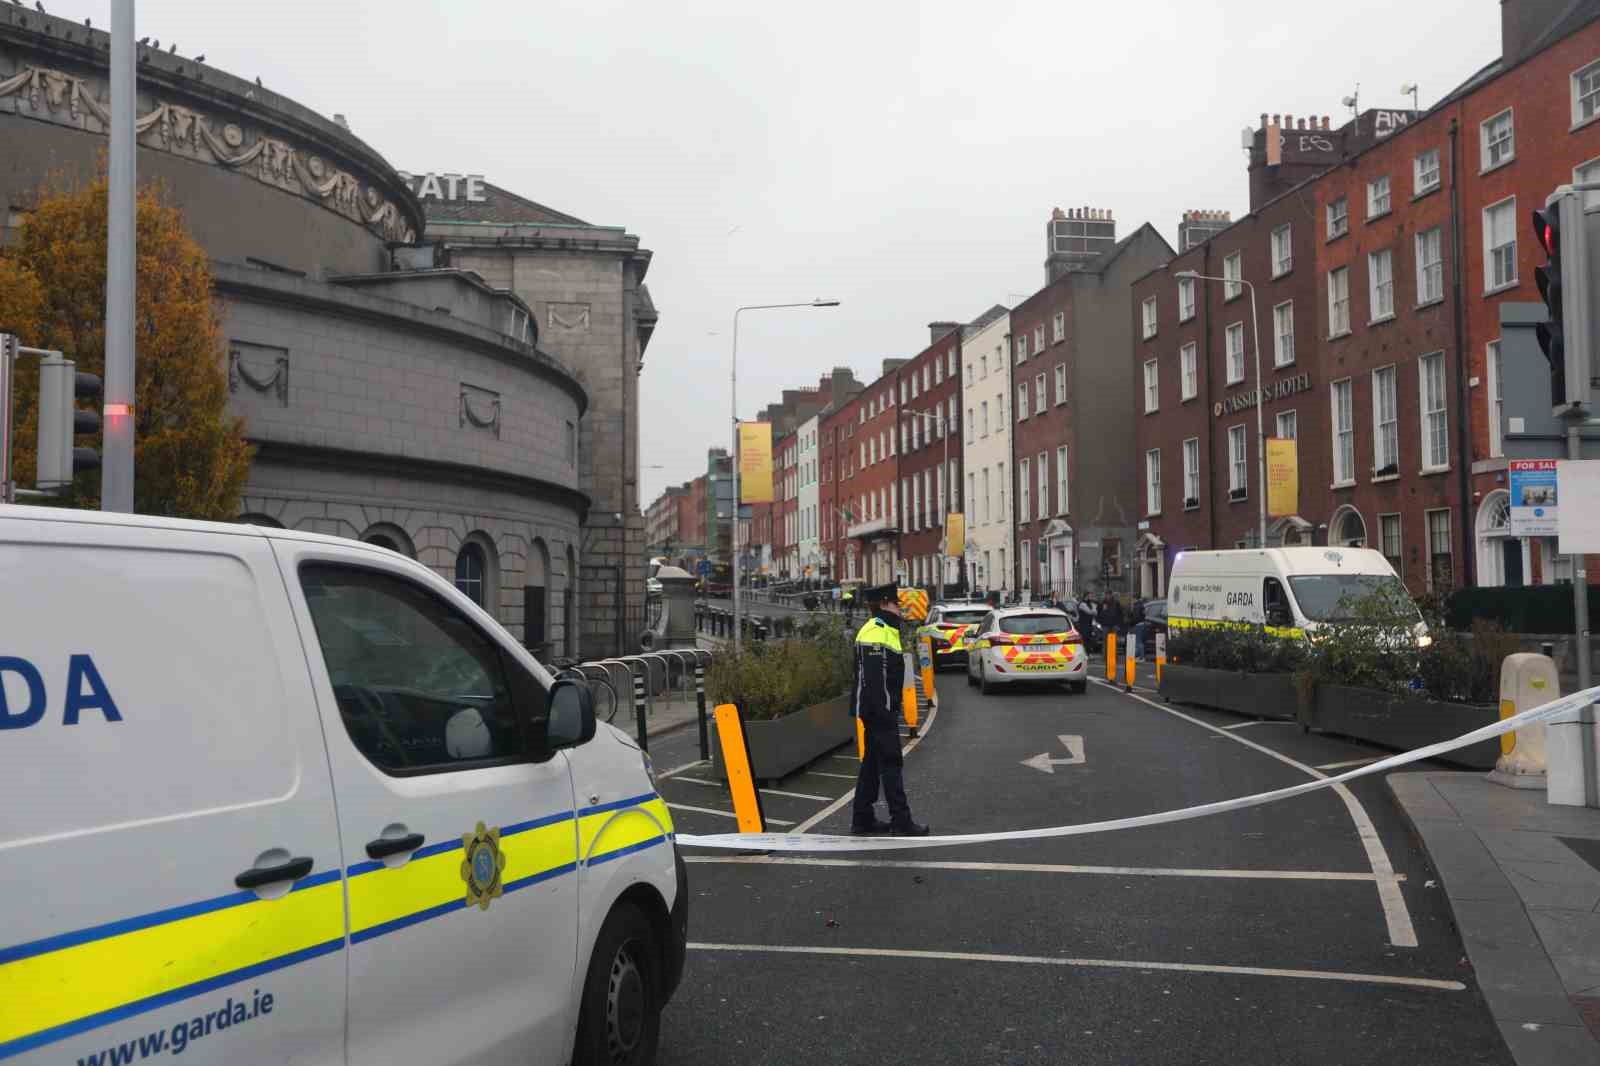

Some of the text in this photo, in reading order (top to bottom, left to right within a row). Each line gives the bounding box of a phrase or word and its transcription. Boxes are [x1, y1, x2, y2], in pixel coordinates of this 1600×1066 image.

[1274, 372, 1312, 400] HOTEL
[1516, 462, 1557, 471] FOR SAL
[1226, 591, 1254, 606] GARDA
[0, 654, 124, 731] DA
[76, 988, 274, 1066] www.garda.ie
